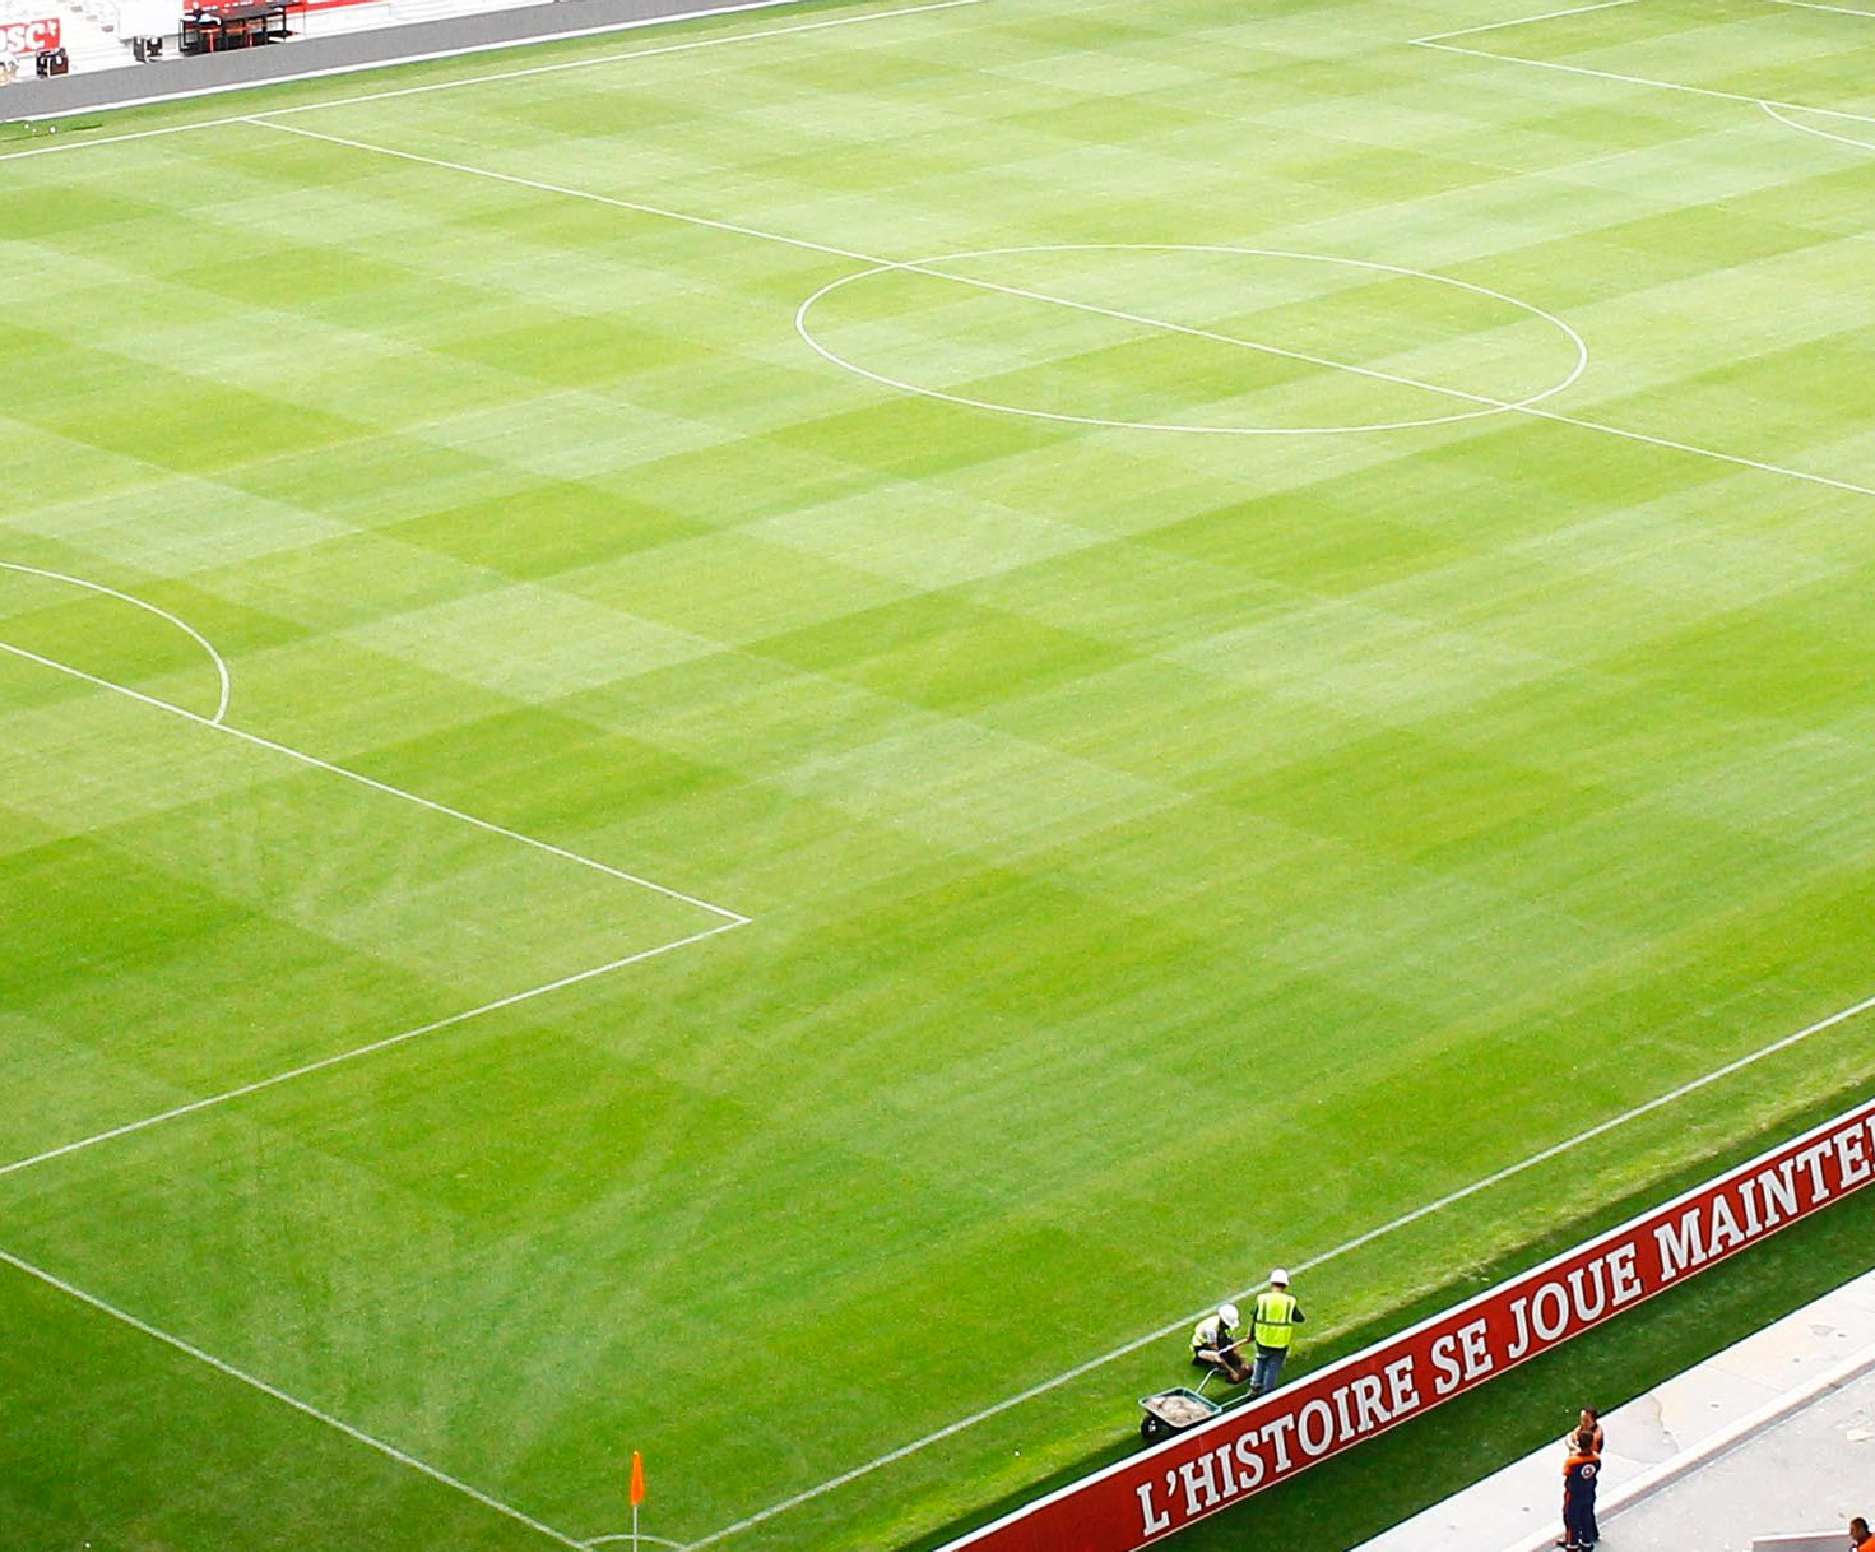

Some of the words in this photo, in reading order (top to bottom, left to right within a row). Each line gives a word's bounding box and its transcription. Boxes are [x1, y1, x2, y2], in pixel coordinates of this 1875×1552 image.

[1136, 1358, 1422, 1537] L'HISTOIRE
[1430, 1323, 1493, 1397] SE
[1502, 1239, 1644, 1360] JOUE
